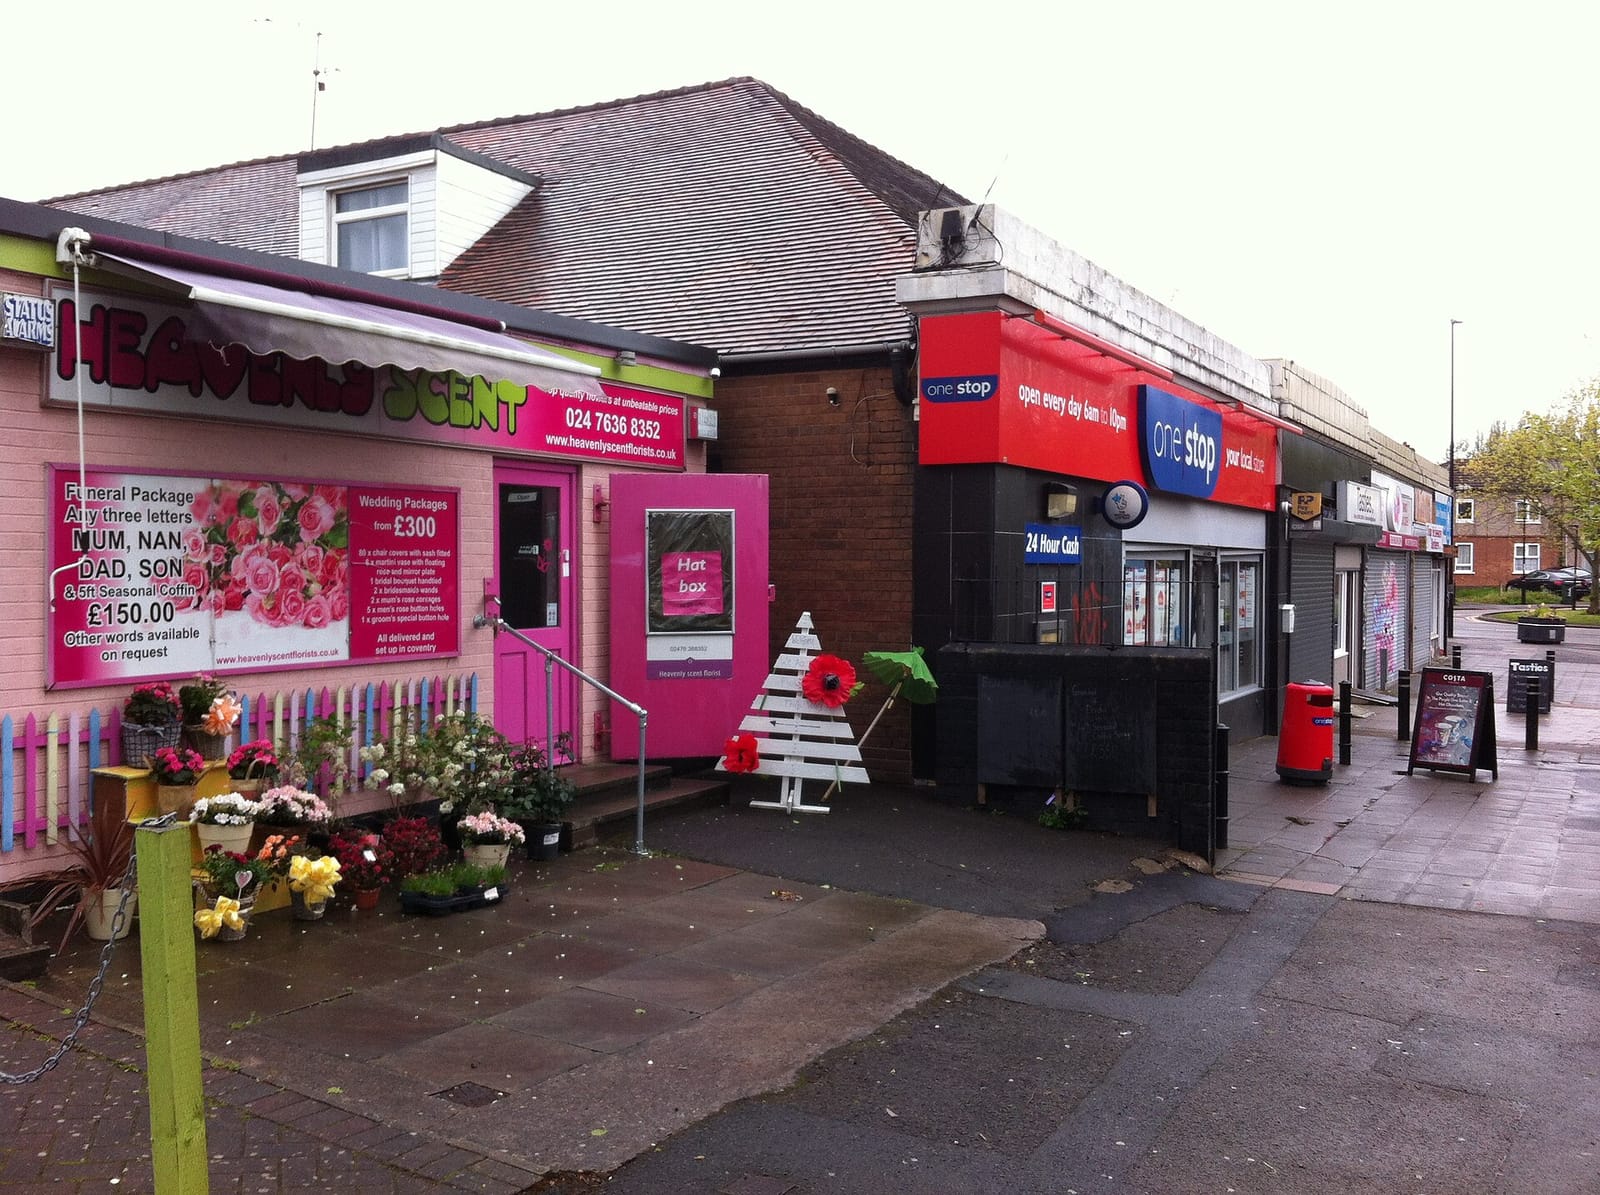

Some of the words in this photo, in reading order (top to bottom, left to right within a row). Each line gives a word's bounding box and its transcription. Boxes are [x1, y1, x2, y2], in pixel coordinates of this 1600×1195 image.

[4, 296, 54, 325] STATUS
[57, 298, 374, 417] HEAVENLY
[382, 367, 528, 435] SCENT
[927, 384, 954, 396] one
[957, 380, 991, 398] stop
[613, 397, 622, 406] at
[621, 397, 658, 413] unbeatable
[658, 404, 679, 416] prices
[1018, 384, 1041, 408] open
[1043, 392, 1066, 417] every
[1068, 394, 1083, 421] day
[1083, 399, 1099, 423] 6am
[1100, 406, 1109, 424] to
[1109, 405, 1127, 433] 10pm
[566, 407, 592, 430] 024
[595, 412, 627, 435] 7636
[630, 417, 660, 440] 8352
[545, 433, 677, 461] www.heavenlyscentflorists.co.uk
[1153, 421, 1182, 462] one
[1184, 422, 1216, 485] stop
[1225, 447, 1240, 468] your
[1240, 446, 1253, 471] local
[65, 484, 126, 502] Funeral
[130, 486, 194, 506] Package
[359, 495, 402, 511] Wedding
[404, 496, 448, 512] Packages
[65, 506, 98, 525] Any
[102, 507, 143, 523] three
[147, 508, 193, 524] letters
[373, 520, 392, 531] from
[394, 514, 436, 538] £300
[74, 529, 131, 553] MUM,
[138, 531, 188, 553] NAN,
[1025, 532, 1038, 553] 24
[1040, 533, 1061, 554] Hour
[1061, 535, 1080, 556] Cash
[372, 549, 388, 557] chair
[388, 550, 408, 558] covers
[409, 549, 421, 557] with
[422, 550, 436, 558] sash
[436, 549, 451, 558] fitted
[79, 558, 132, 581] DAD,
[139, 559, 184, 579] SON
[375, 559, 396, 567] martini
[411, 559, 424, 567] with
[424, 558, 446, 569] floating
[391, 568, 402, 576] and
[402, 568, 420, 576] mirror
[421, 568, 436, 577] plate
[677, 557, 707, 572] Hat
[375, 577, 392, 585] bridal
[393, 577, 417, 586] bouquet
[417, 577, 442, 585] handtied
[420, 586, 438, 594] wands
[679, 579, 707, 593] box
[65, 585, 75, 599] &
[79, 585, 96, 599] 5ft
[99, 584, 157, 598] Seasonal
[159, 583, 196, 597] Coffin
[380, 596, 400, 604] mum's
[401, 596, 415, 604] rose
[88, 602, 175, 626] £150.00
[377, 605, 395, 614] men's
[410, 604, 429, 613] button
[429, 604, 444, 612] holes
[371, 615, 396, 625] groom's
[397, 614, 417, 624] special
[418, 613, 437, 622] button
[437, 613, 450, 621] hole
[64, 631, 102, 647] Other
[106, 629, 144, 644] words
[147, 627, 200, 642] available
[377, 633, 388, 643] All
[388, 632, 421, 643] delivered
[421, 632, 435, 641] and
[101, 650, 118, 662] on
[121, 645, 168, 662] request
[216, 647, 339, 665] www.heavenlyscentflorists.co.uk
[375, 646, 387, 655] set
[387, 645, 398, 655] up
[398, 645, 406, 653] in
[407, 643, 437, 654] coventry
[659, 669, 686, 678] Heavenly
[703, 668, 721, 677] florist
[1443, 674, 1466, 682] COSTA
